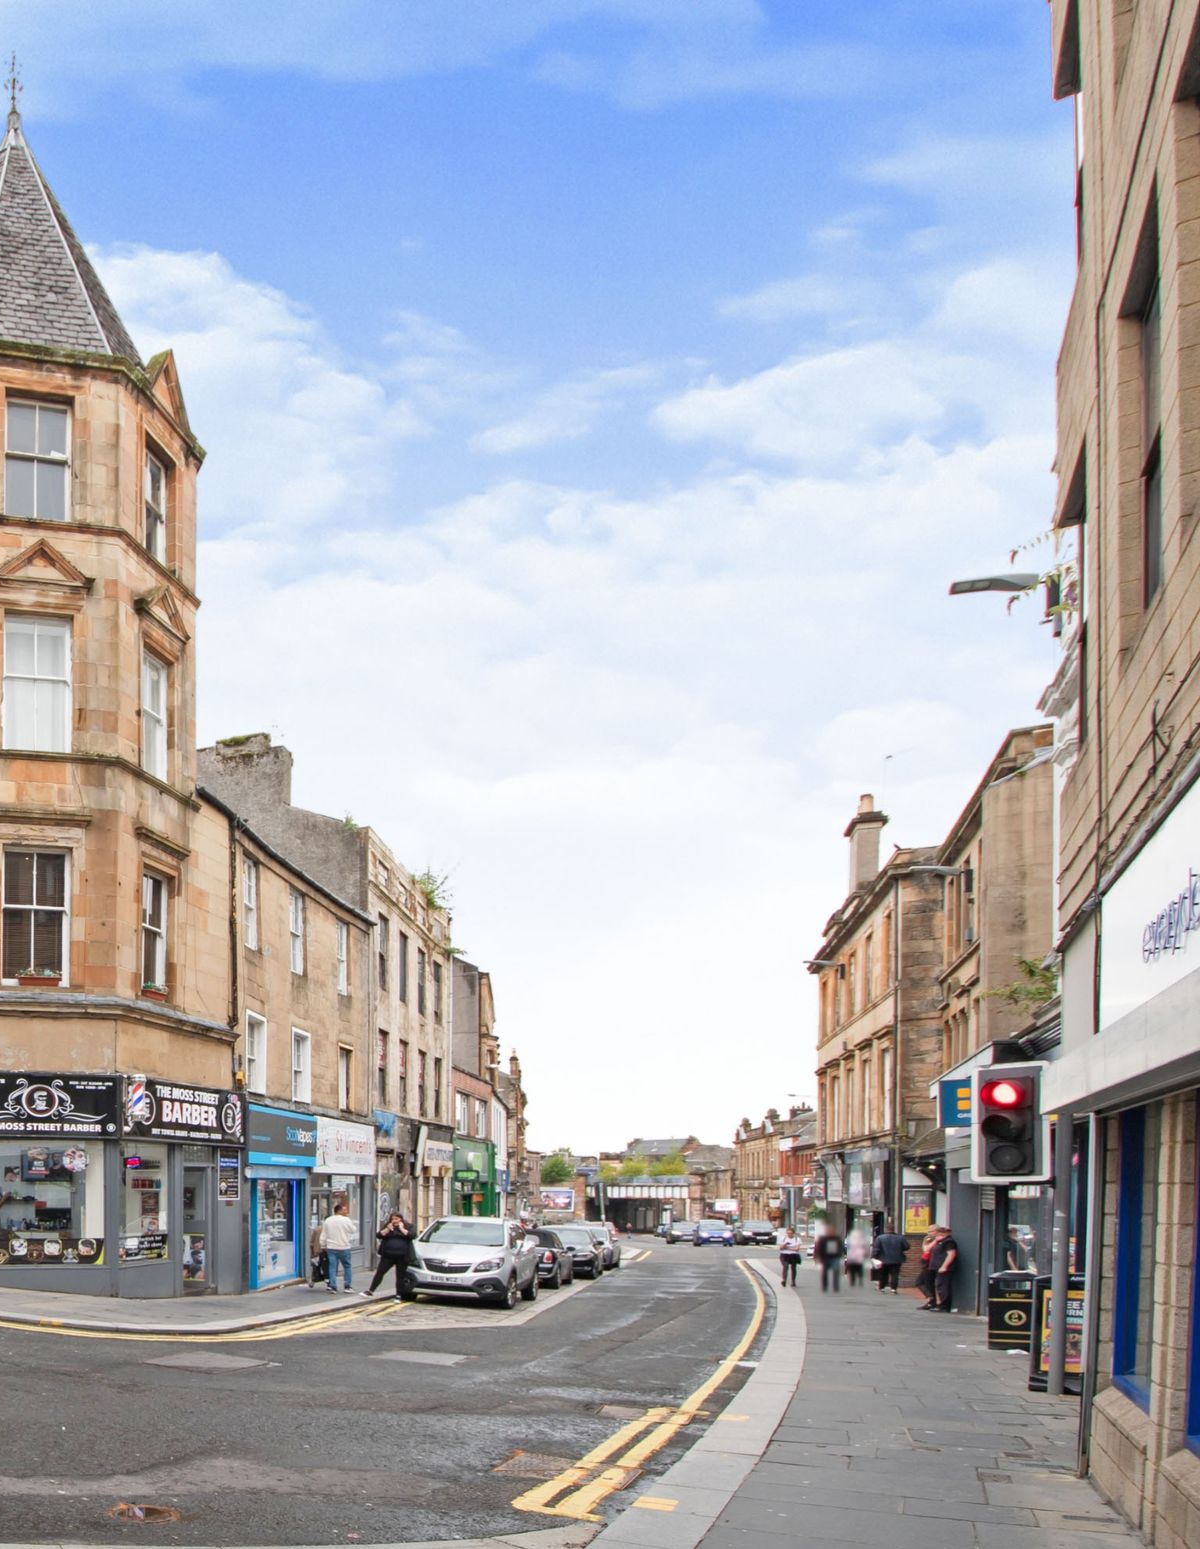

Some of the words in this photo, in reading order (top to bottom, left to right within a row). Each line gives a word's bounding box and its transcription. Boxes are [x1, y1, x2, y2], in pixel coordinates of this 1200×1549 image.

[156, 1086, 172, 1098] THE
[173, 1087, 193, 1101] MOSS
[194, 1090, 219, 1105] STREET
[161, 1100, 217, 1127] BARBER
[27, 1122, 62, 1131] STREET
[63, 1124, 101, 1132] BARBER
